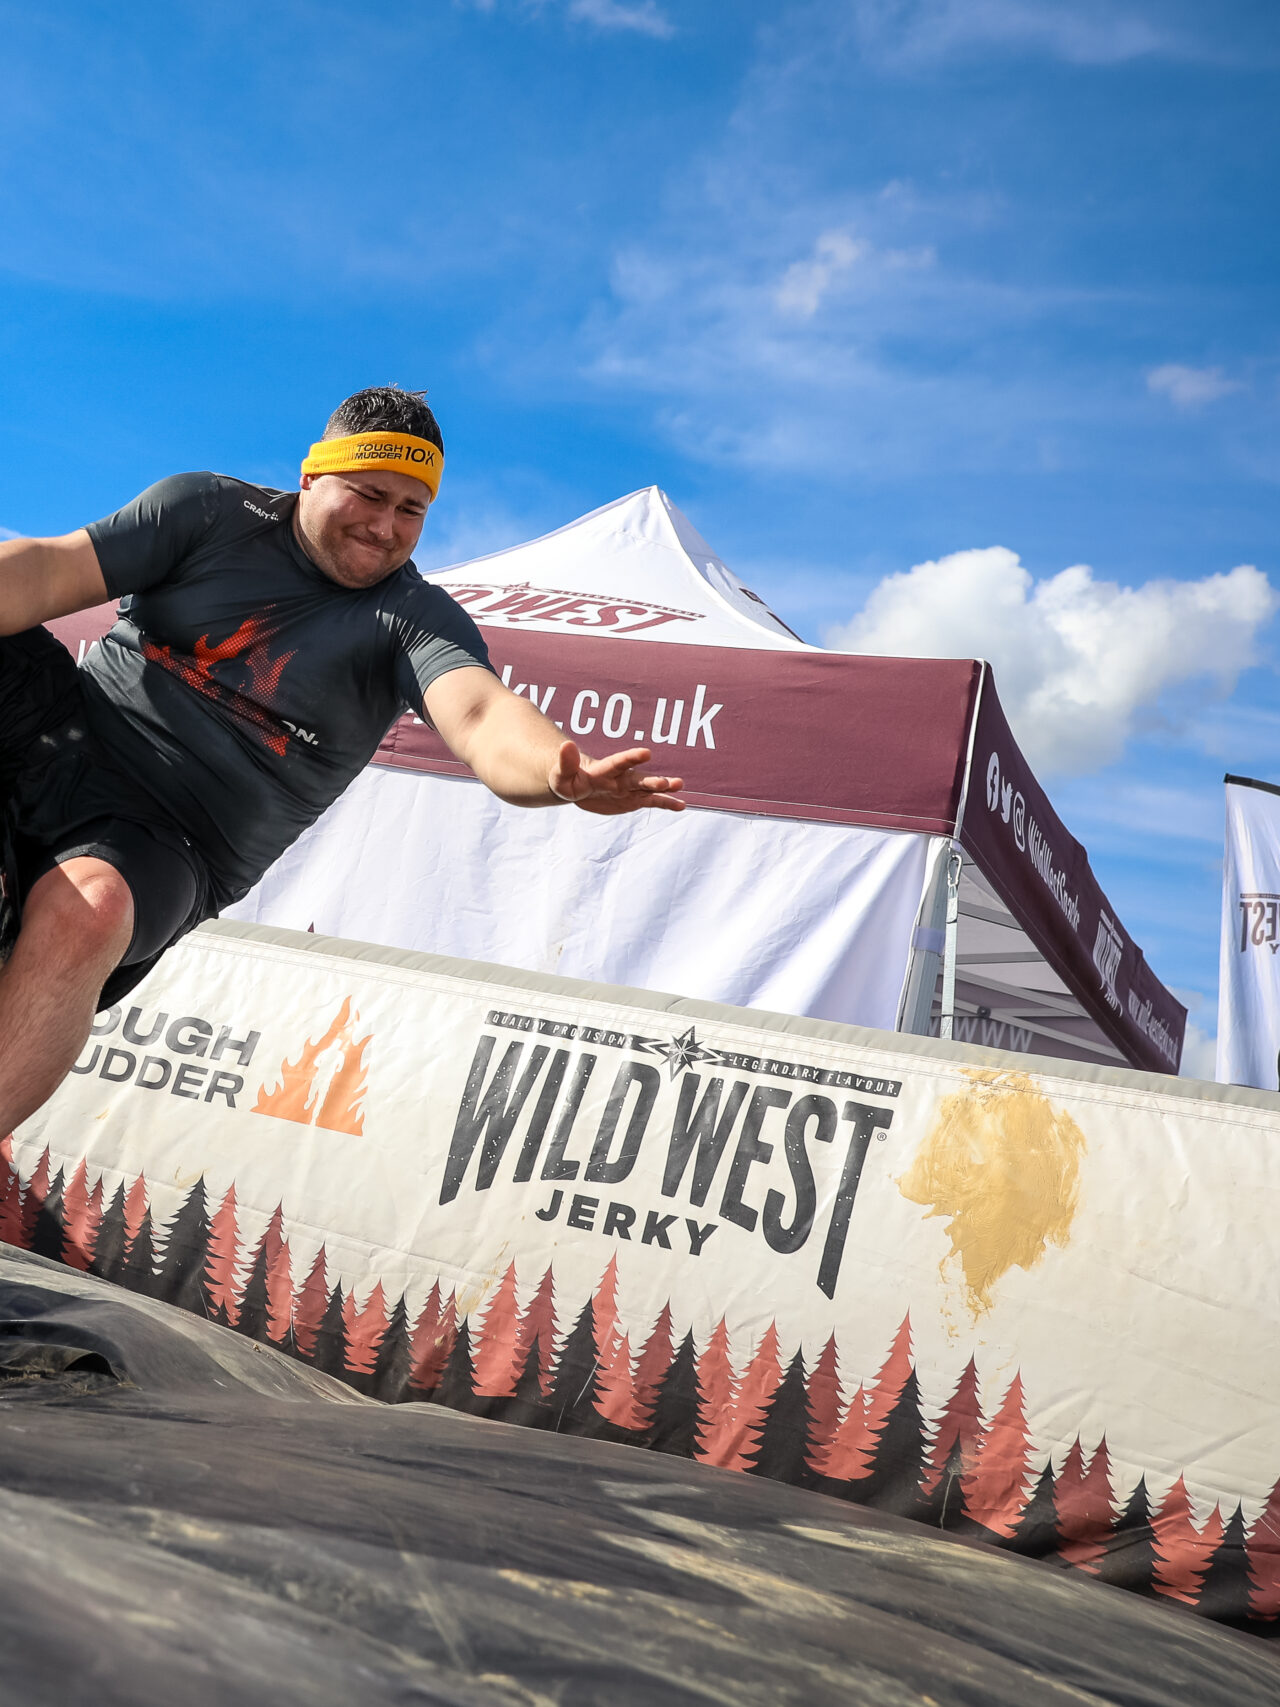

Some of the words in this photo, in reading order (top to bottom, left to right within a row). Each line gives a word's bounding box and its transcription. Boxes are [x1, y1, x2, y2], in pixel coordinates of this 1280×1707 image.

[354, 452, 402, 460] MUDDER
[356, 443, 404, 452] TOUGH
[405, 446, 435, 467] 10K
[478, 593, 698, 634] WEST
[501, 664, 724, 750] ky.co.uk
[91, 1004, 261, 1067] OUGH
[492, 1013, 546, 1031] QUALITY
[552, 1024, 634, 1046] PROVISIONS
[732, 1055, 819, 1081] LEGENDARY
[827, 1073, 897, 1095] FLAVOUR
[70, 1044, 245, 1109] UDDER
[439, 1035, 661, 1206] WILD
[661, 1072, 895, 1300] WEST
[535, 1189, 719, 1257] JERKY
